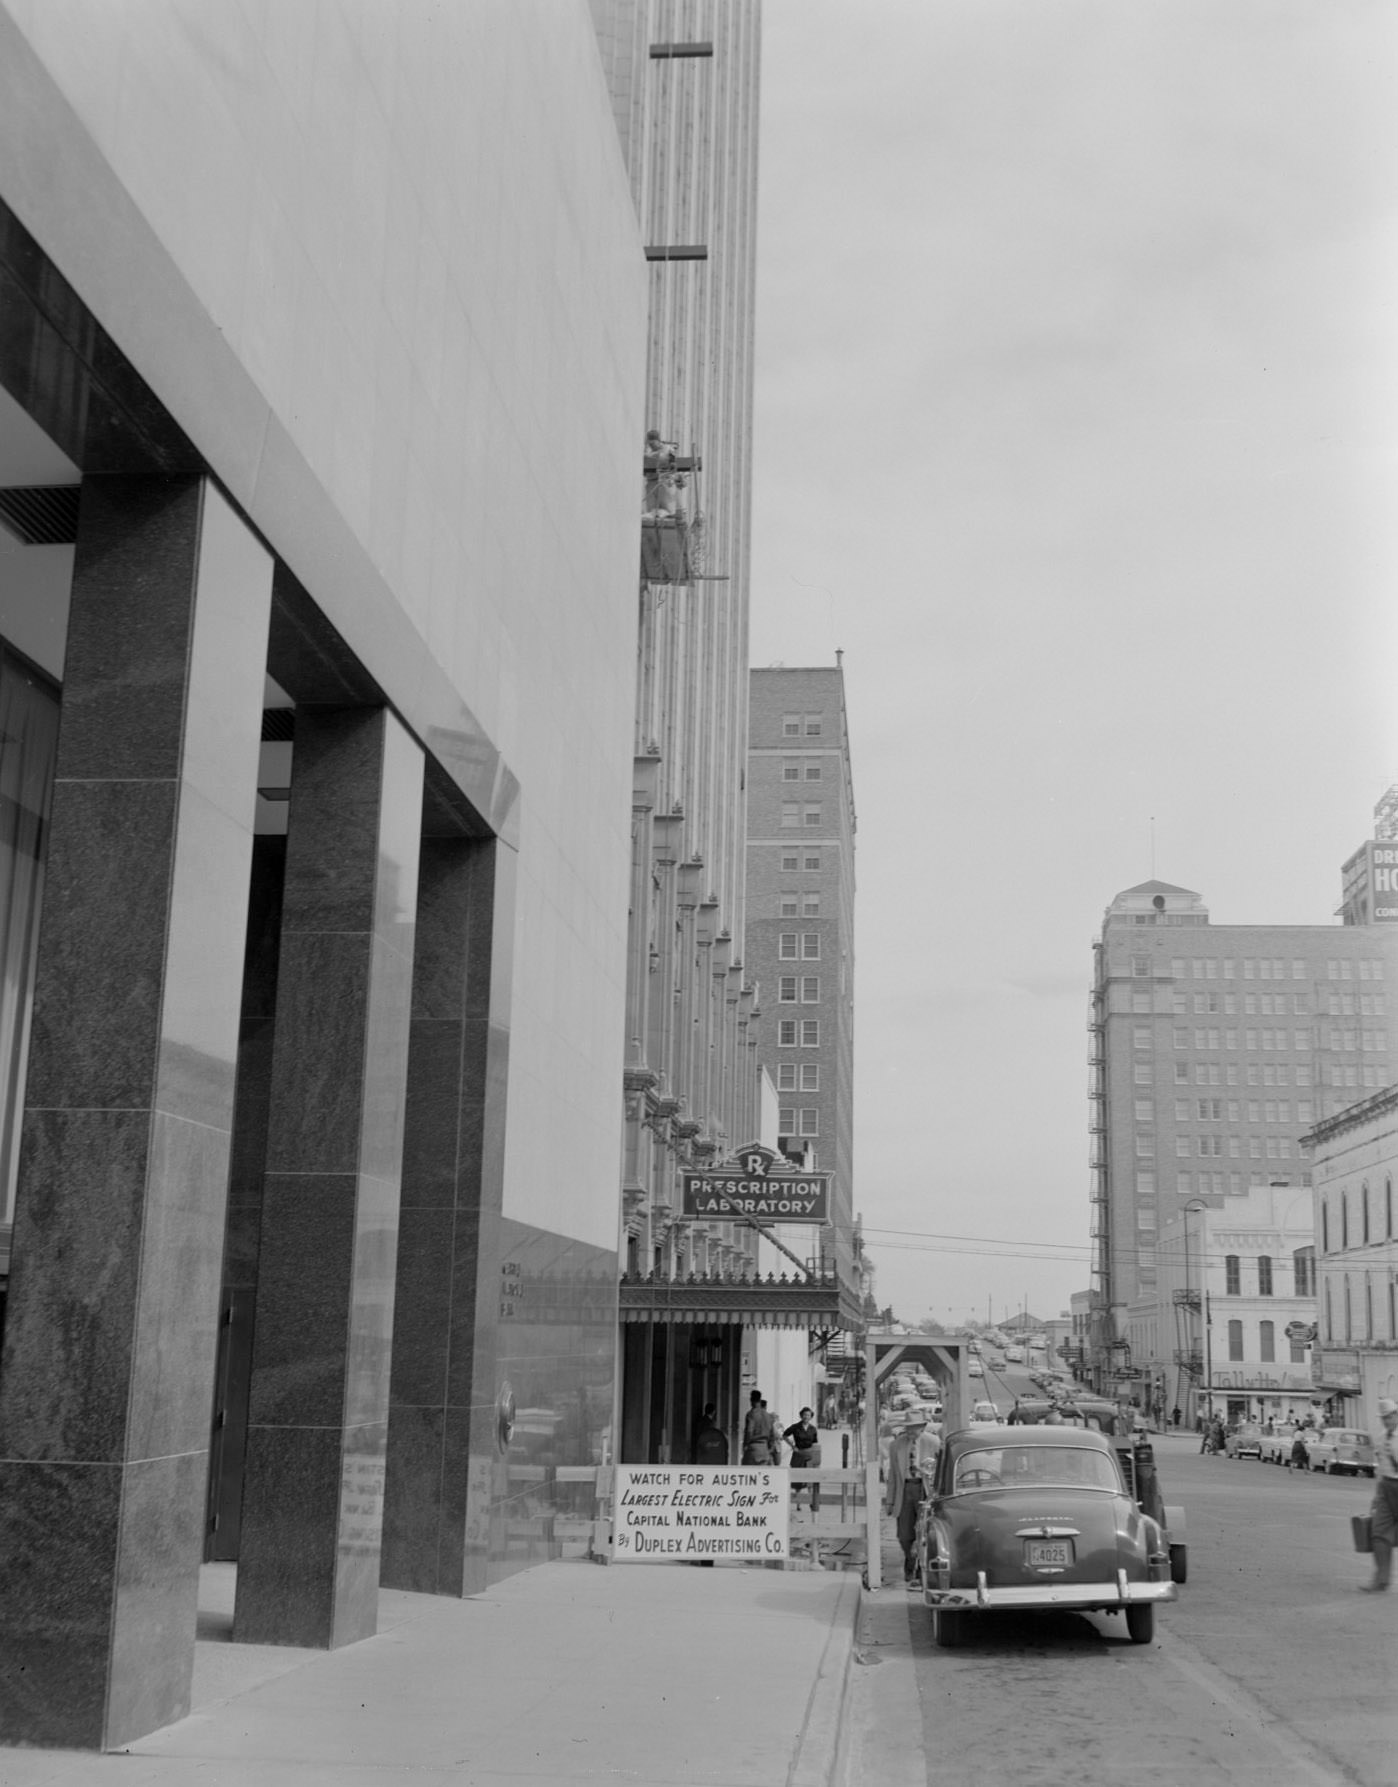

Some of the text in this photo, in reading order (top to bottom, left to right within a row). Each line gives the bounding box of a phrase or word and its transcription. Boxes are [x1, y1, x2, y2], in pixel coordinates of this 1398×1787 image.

[690, 1180, 821, 1196] PRESCRIPTION
[696, 1198, 817, 1214] LABORATORY
[629, 1472, 771, 1486] WATCH FOR AUSTIN'S
[620, 1489, 669, 1506] LARGEST
[670, 1490, 724, 1507] ELECTRIC
[727, 1490, 756, 1507] SIGN
[626, 1510, 768, 1527] CAPITAL NATIONAL BANK
[635, 1531, 683, 1553] DUPLEX
[686, 1531, 761, 1554] ADVERTISING
